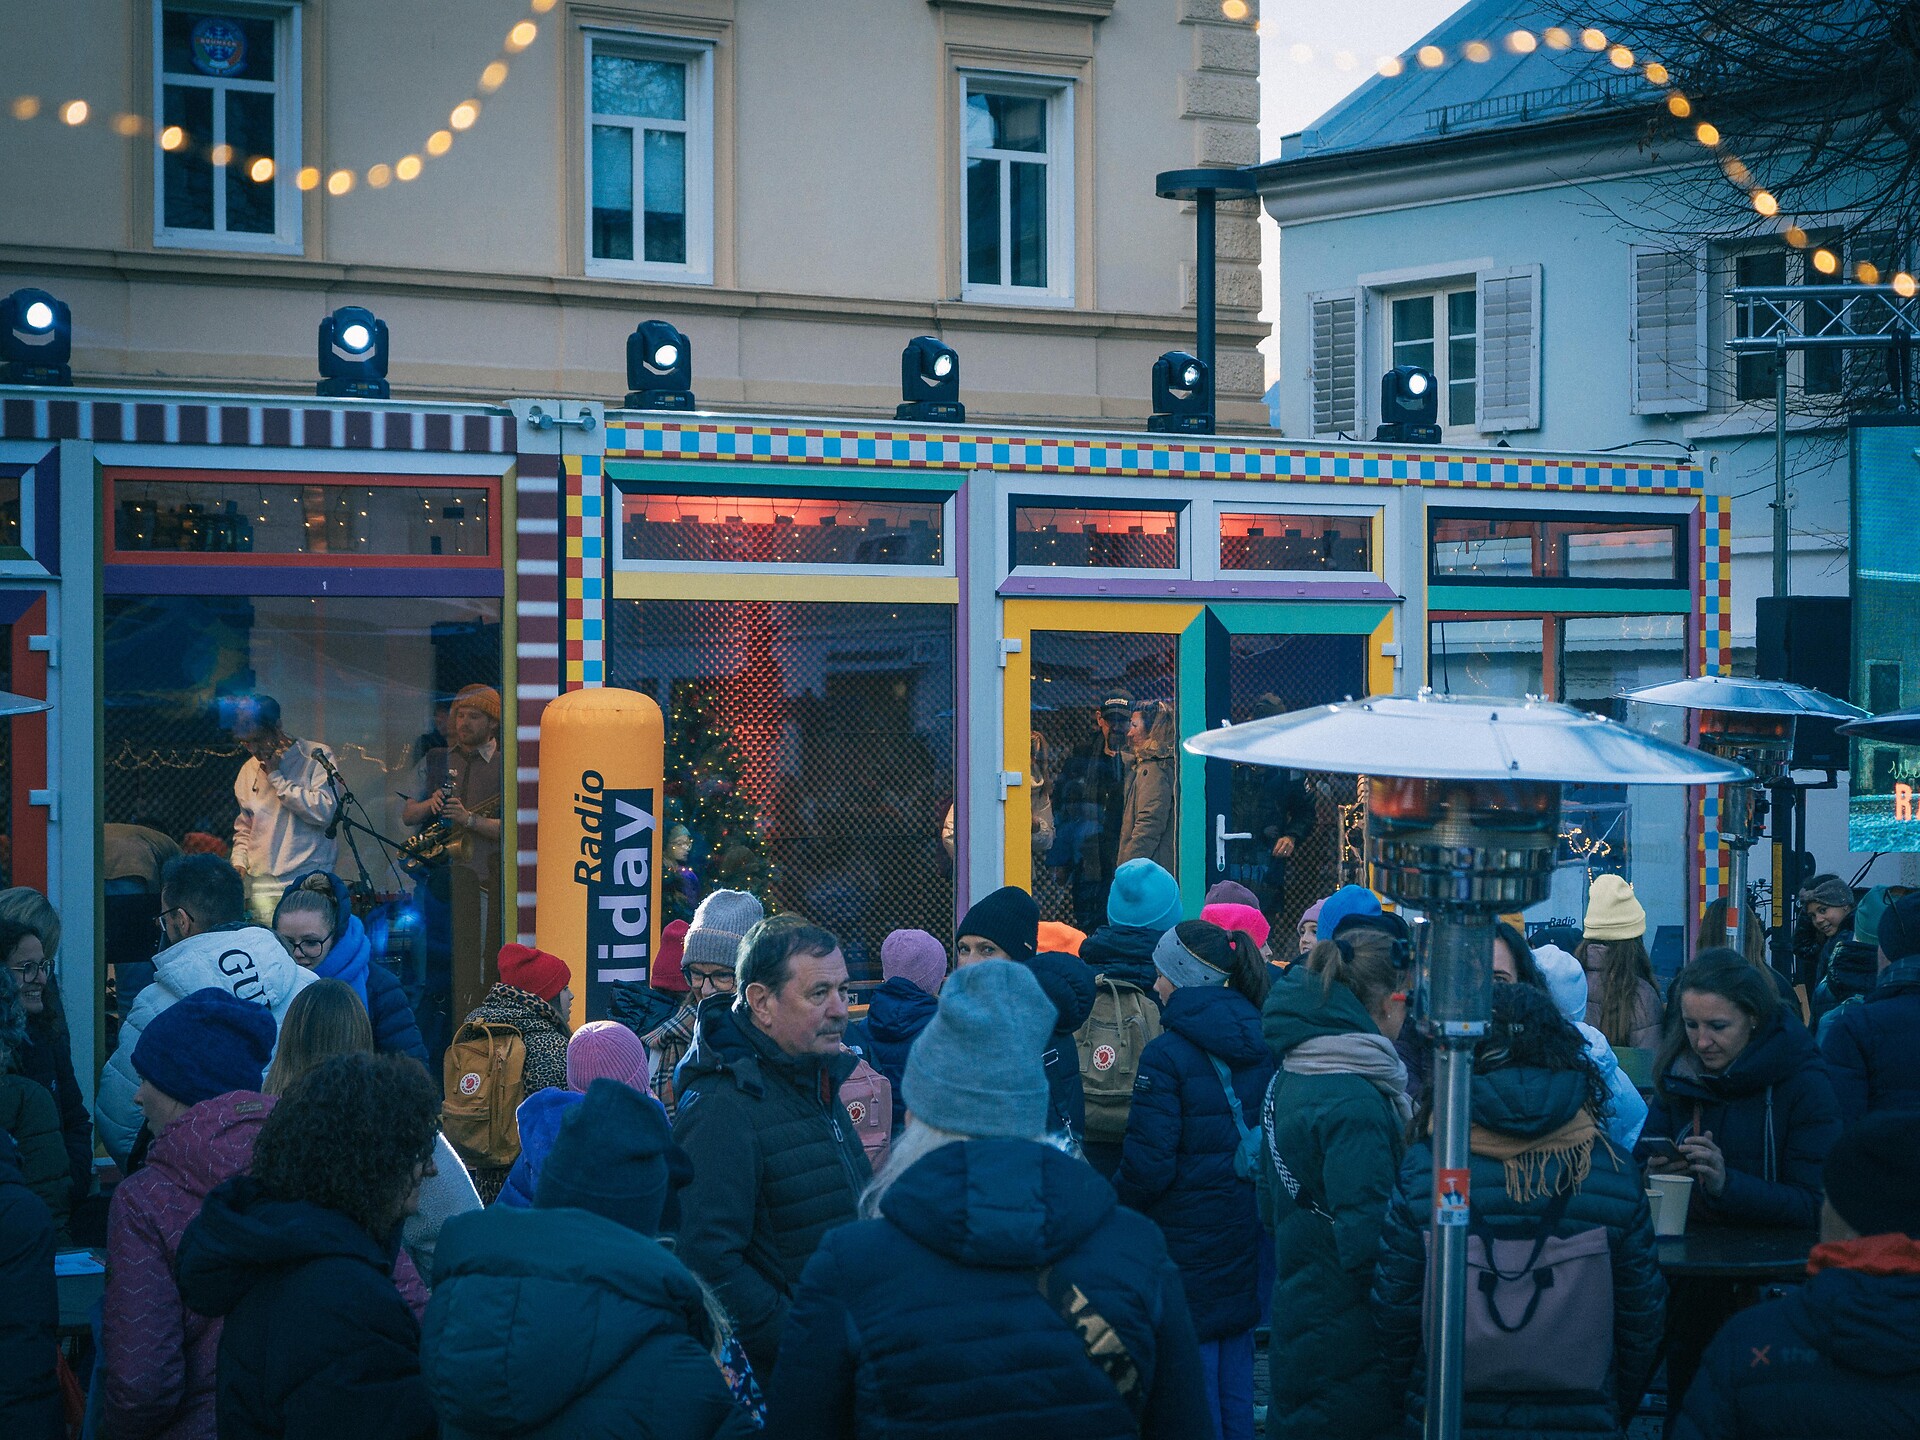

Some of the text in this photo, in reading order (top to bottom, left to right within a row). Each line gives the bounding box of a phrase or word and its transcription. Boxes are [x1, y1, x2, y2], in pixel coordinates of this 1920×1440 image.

[574, 769, 605, 886] Radio
[597, 798, 657, 983] liday
[1550, 916, 1576, 927] Radio
[218, 949, 272, 1010] GU
